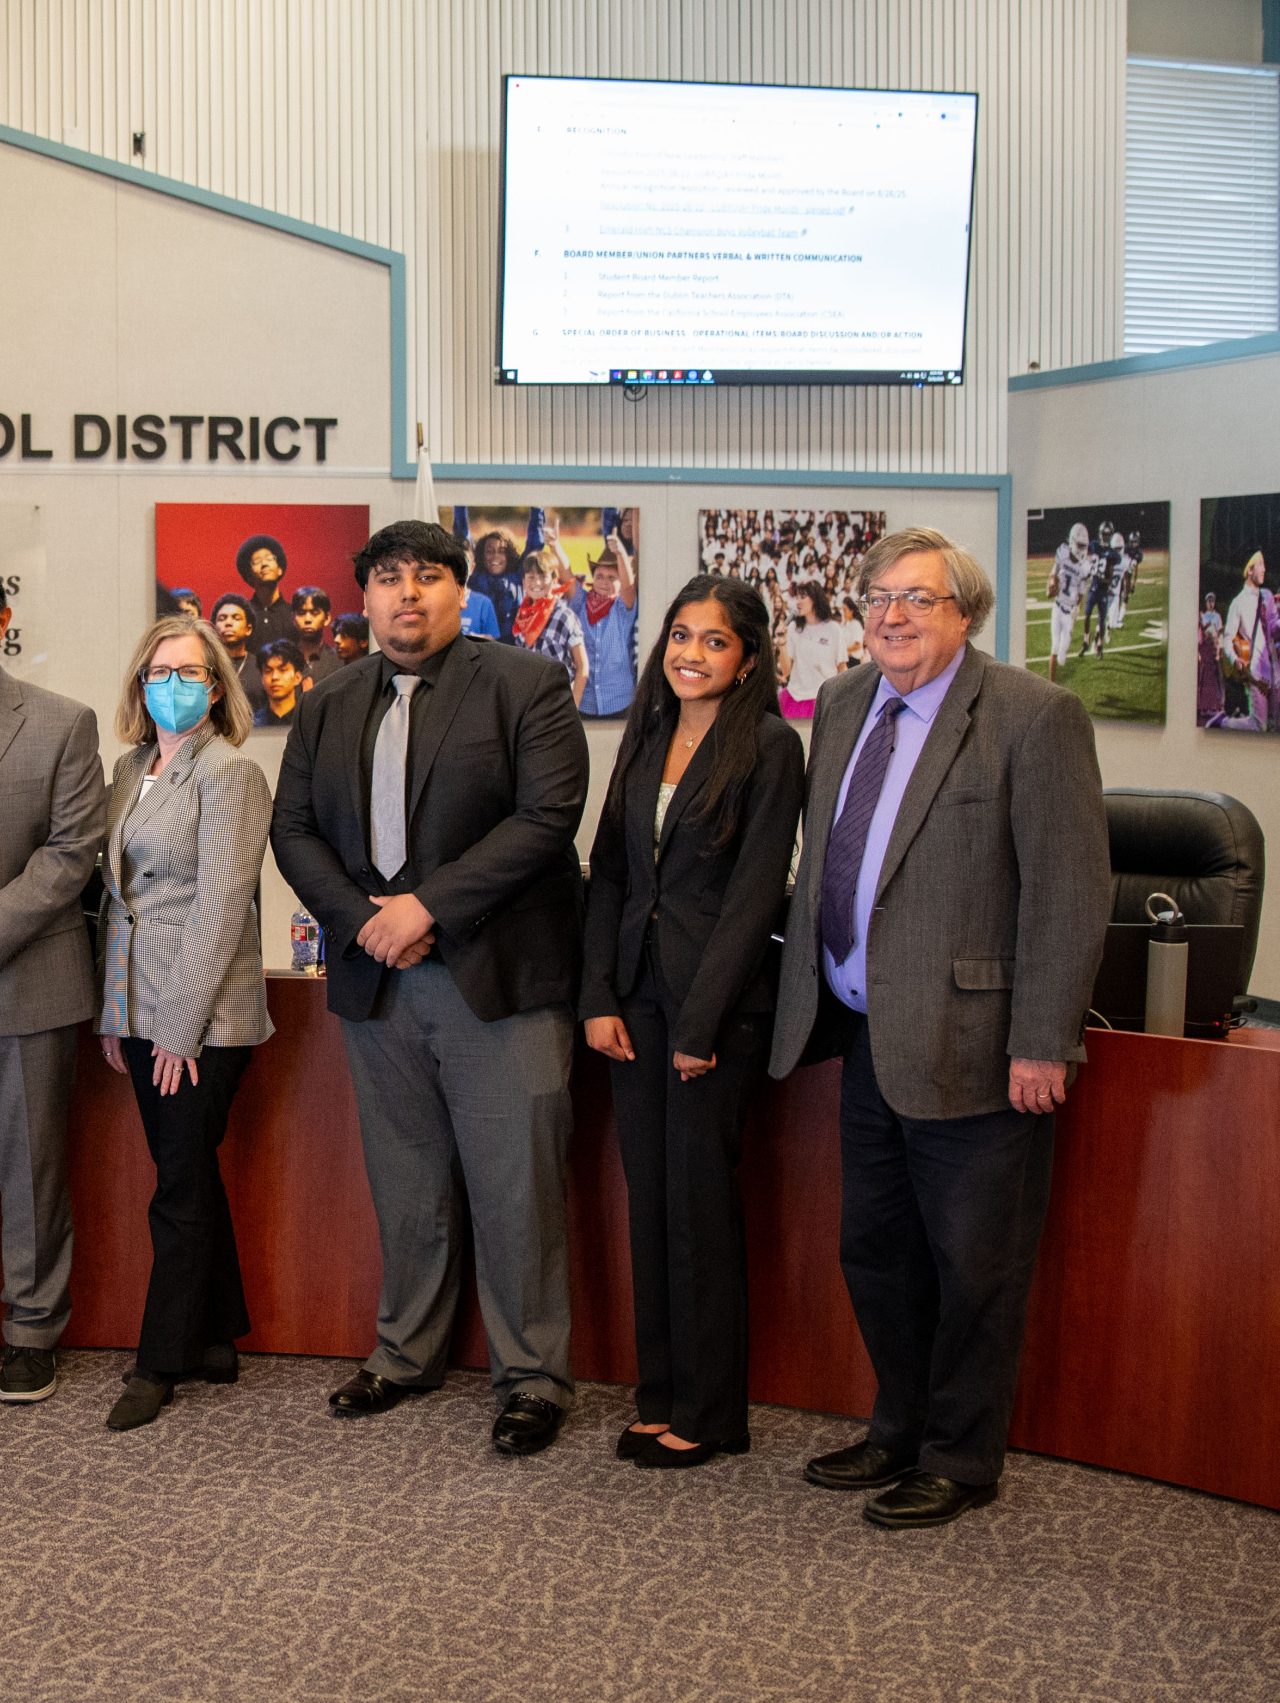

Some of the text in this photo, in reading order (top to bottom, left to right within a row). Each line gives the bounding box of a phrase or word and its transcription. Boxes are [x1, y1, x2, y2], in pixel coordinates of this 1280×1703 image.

[564, 250, 594, 258] BOARD
[667, 252, 710, 260] PARTNERS
[754, 254, 791, 262] WRITTEN
[793, 254, 863, 263] COMMUNICATION
[73, 414, 338, 463] DISTRICT
